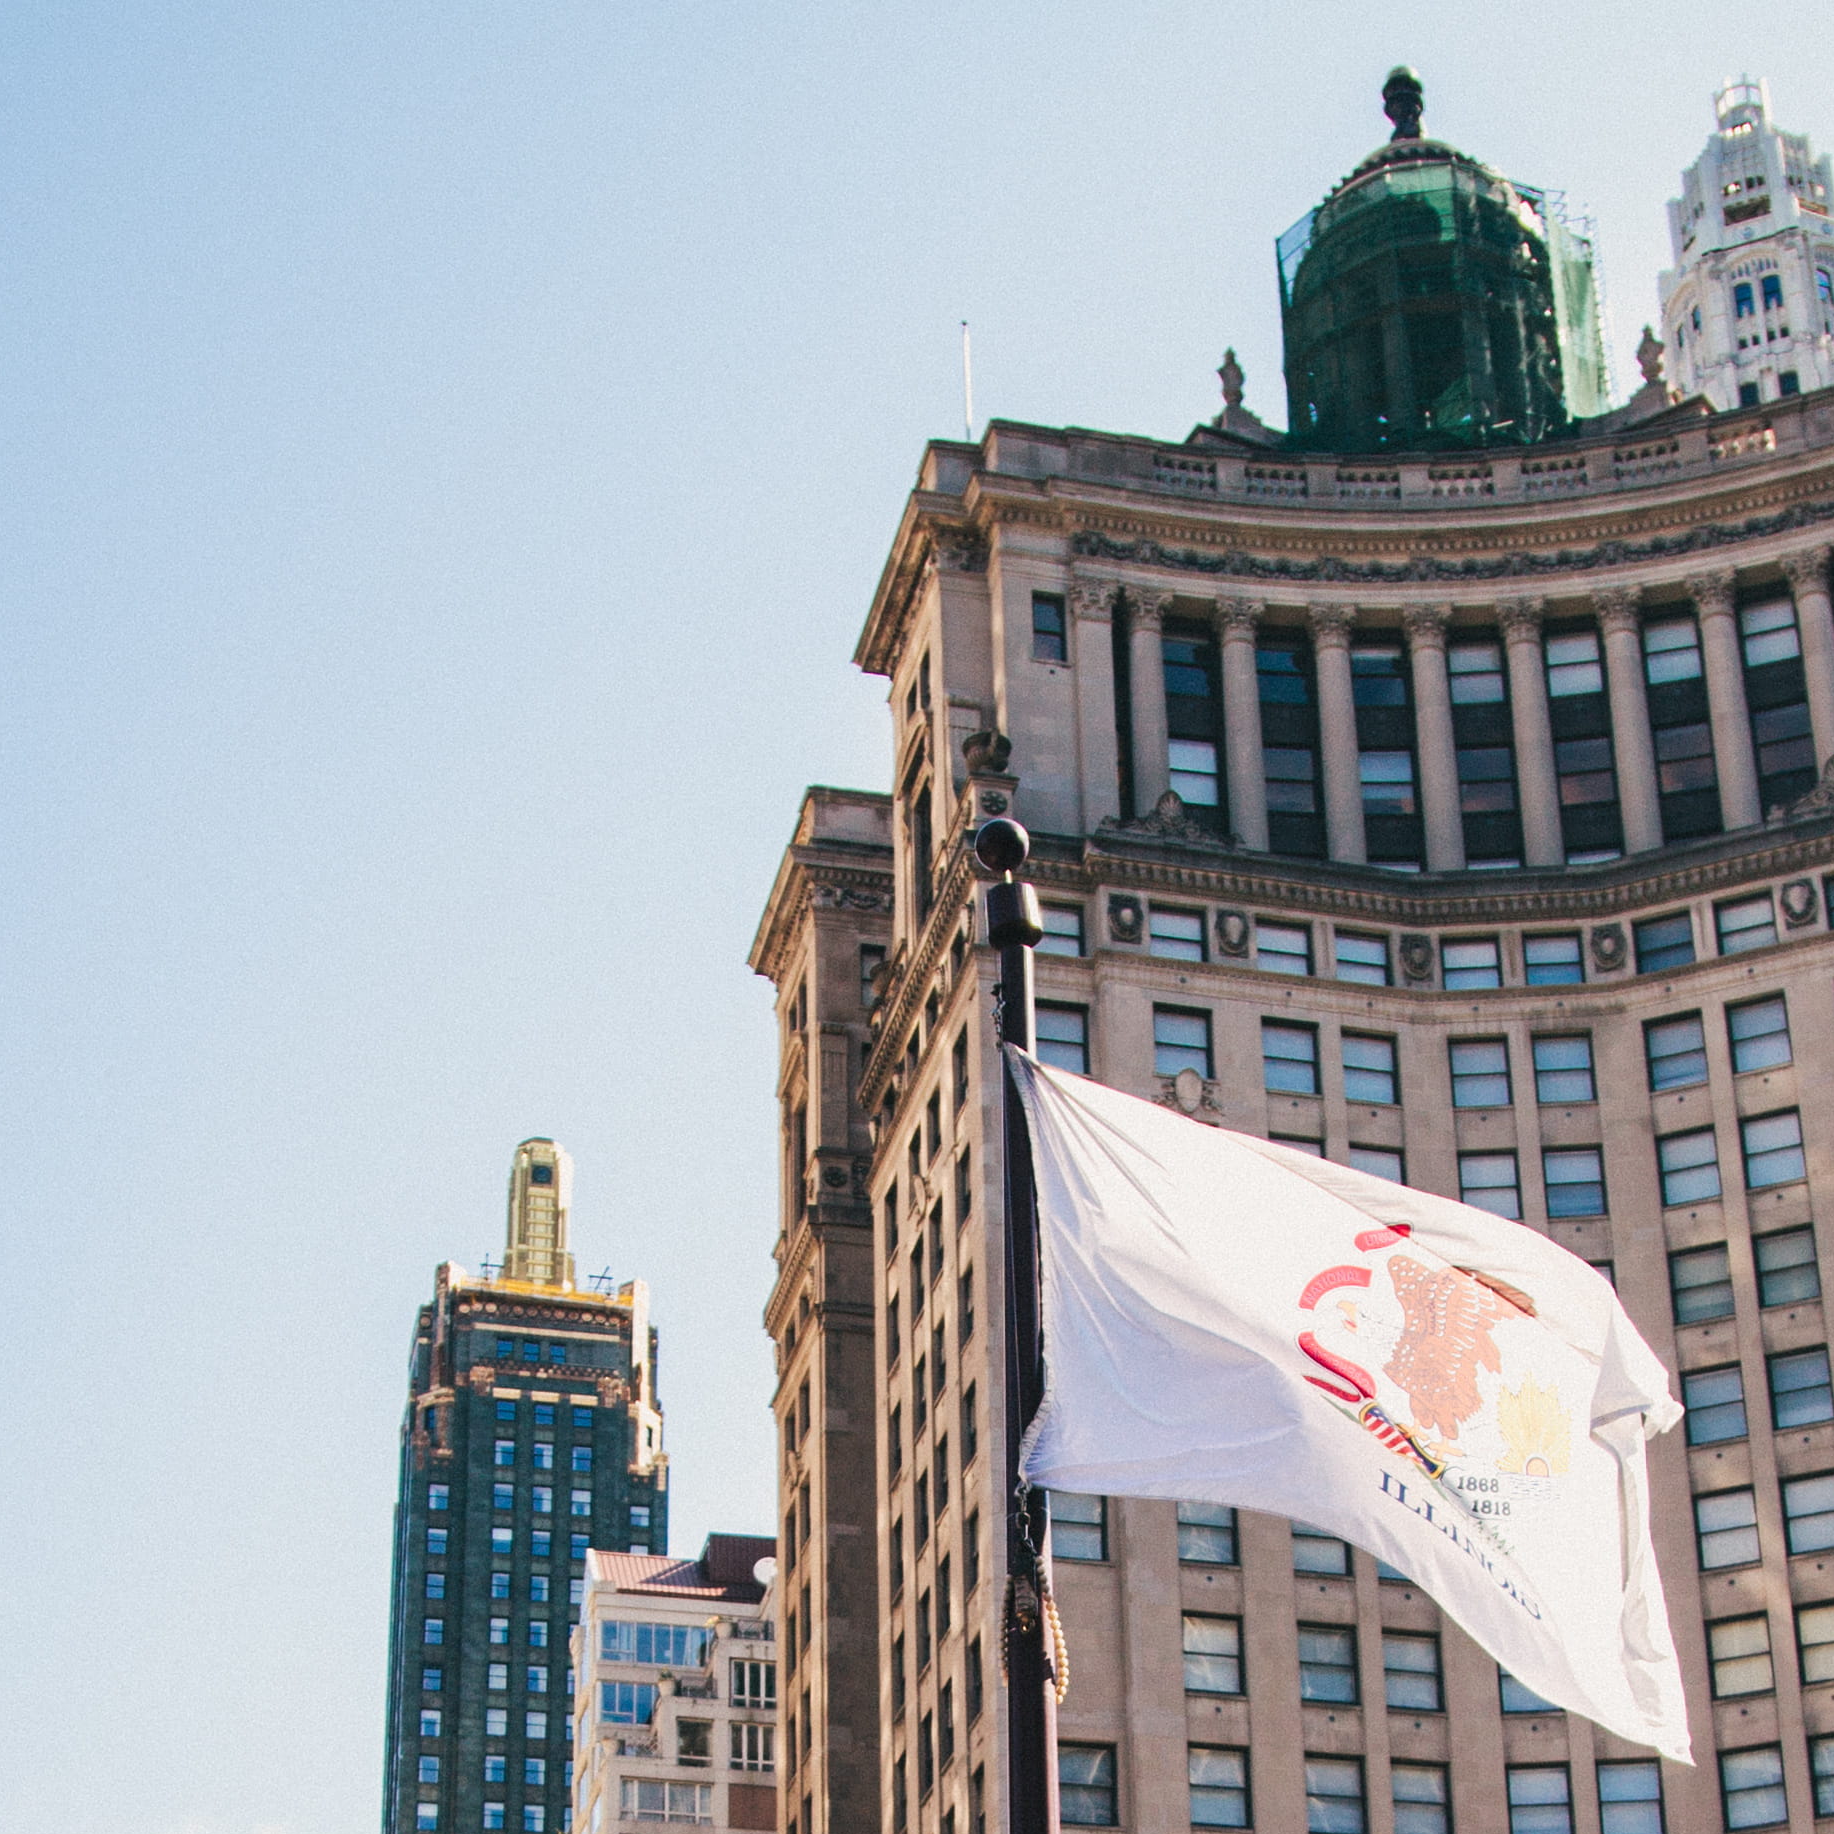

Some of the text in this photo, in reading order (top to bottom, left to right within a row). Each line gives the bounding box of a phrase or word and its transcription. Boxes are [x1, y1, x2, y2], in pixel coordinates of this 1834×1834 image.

[1456, 1475, 1500, 1494] 1868
[1471, 1499, 1512, 1516] 1818
[1378, 1469, 1542, 1620] ILLINOIS
